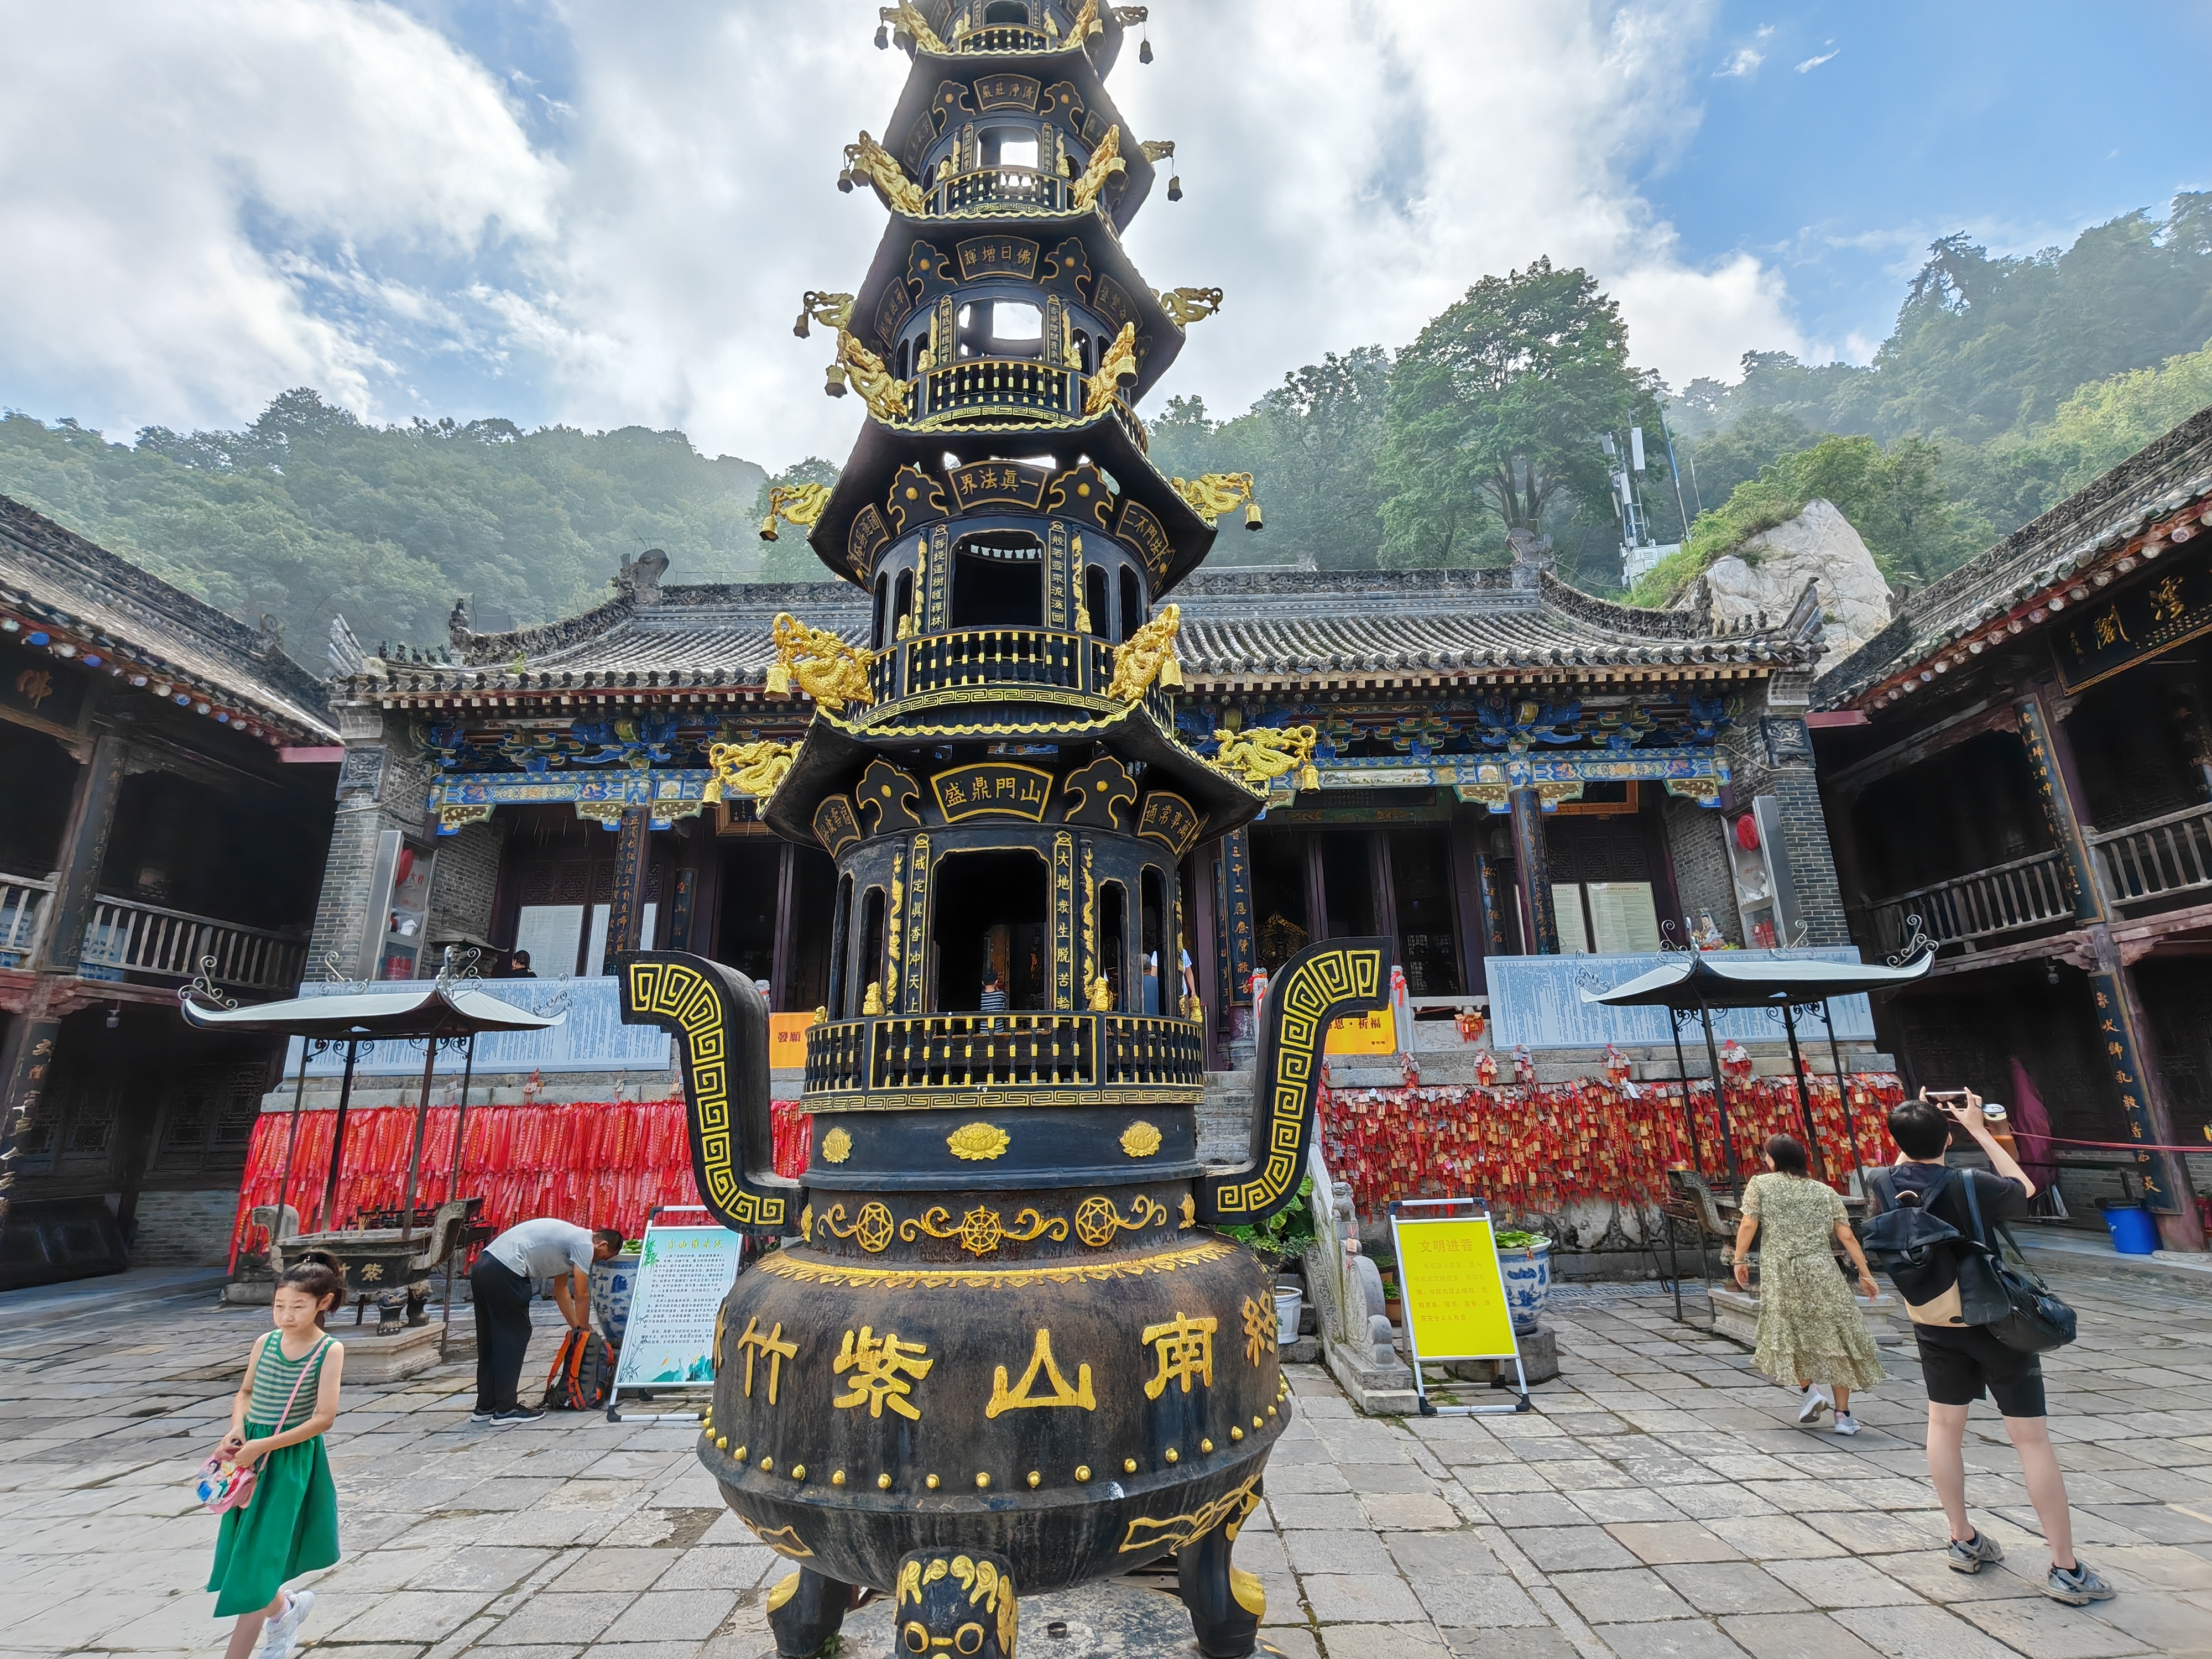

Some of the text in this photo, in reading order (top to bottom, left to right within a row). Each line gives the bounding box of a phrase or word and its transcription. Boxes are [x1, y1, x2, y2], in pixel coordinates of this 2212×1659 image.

[945, 776, 1042, 808] 山門鼎盛
[1419, 1239, 1473, 1253] 文明进香
